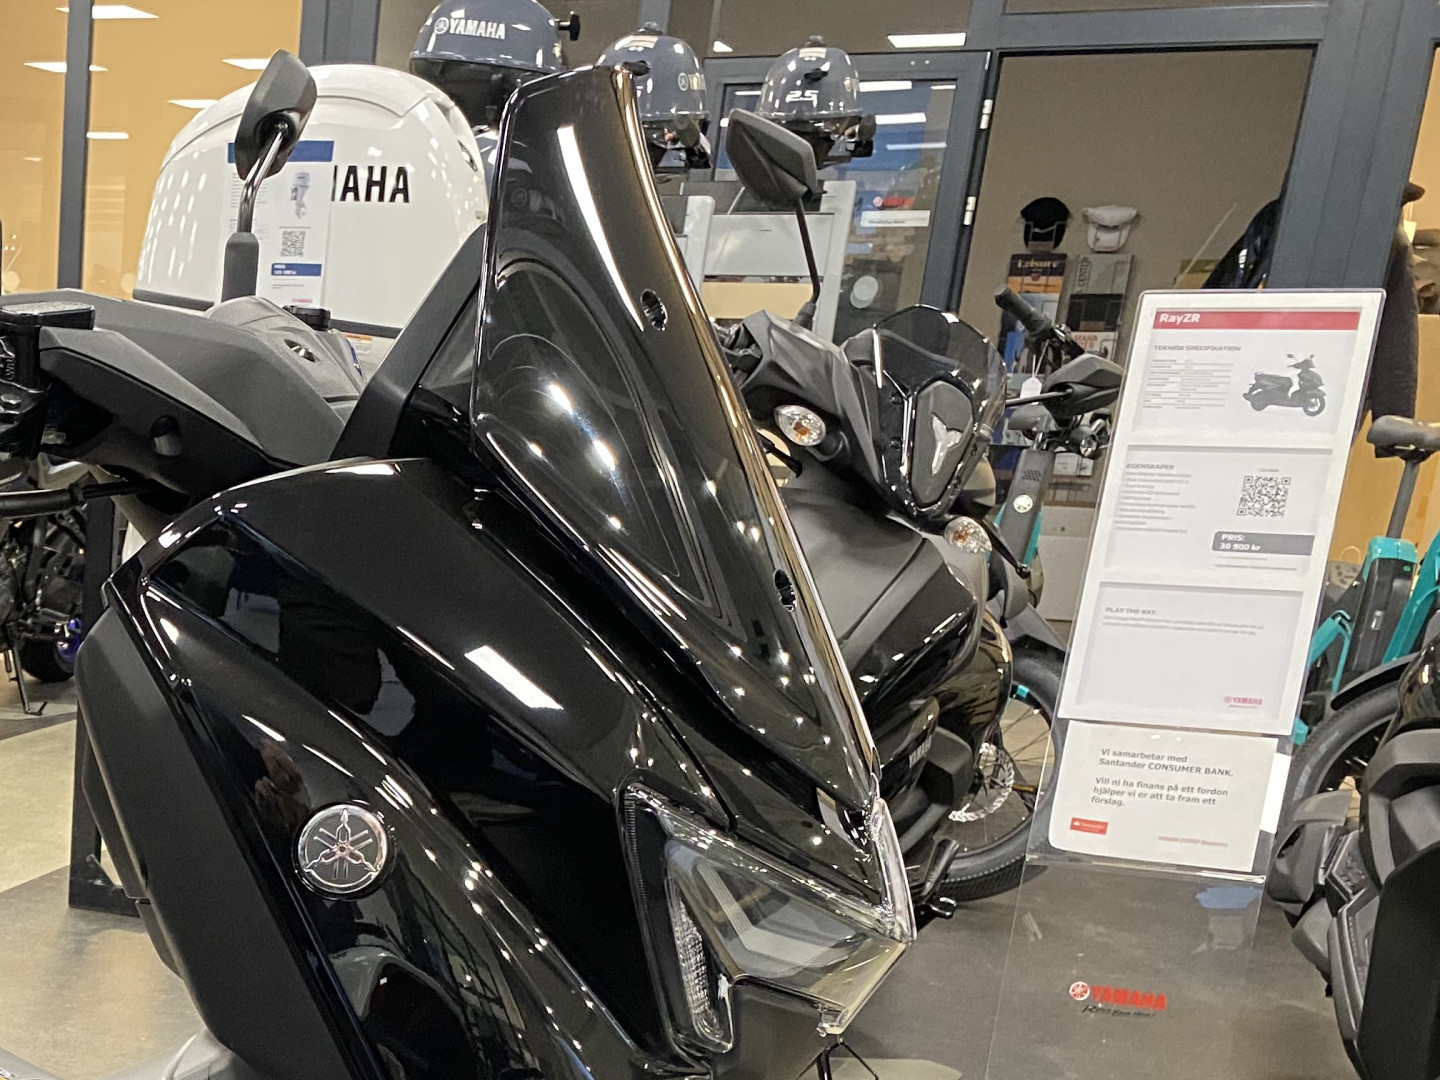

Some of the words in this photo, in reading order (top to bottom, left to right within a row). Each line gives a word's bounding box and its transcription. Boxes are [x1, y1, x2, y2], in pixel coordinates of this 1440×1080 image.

[449, 18, 506, 40] YAMAHA
[331, 165, 410, 203] AHA
[1160, 313, 1201, 325] RayZR
[1251, 543, 1261, 551] kr
[1232, 696, 1263, 705] YAMAHA
[1101, 748, 1110, 756] Vi
[1112, 750, 1165, 761] samarbetar
[1167, 755, 1188, 763] med
[1099, 758, 1147, 769] Santander
[1148, 762, 1202, 774] CONSUMER
[1204, 768, 1234, 777] BANK.
[1093, 786, 1126, 797] hjälper
[1127, 789, 1136, 797] vi
[1149, 791, 1163, 800] att
[1165, 793, 1176, 801] ta
[1177, 794, 1200, 803] fram
[1202, 797, 1216, 805] ett
[1095, 777, 1109, 785] Vill
[1122, 779, 1134, 788] ha
[1136, 781, 1165, 791] finans
[1167, 783, 1179, 793] på
[1181, 785, 1195, 793] ett
[1197, 786, 1229, 796] fordon
[1091, 796, 1125, 807] förslag.
[1091, 985, 1167, 1011] YAMAHA
